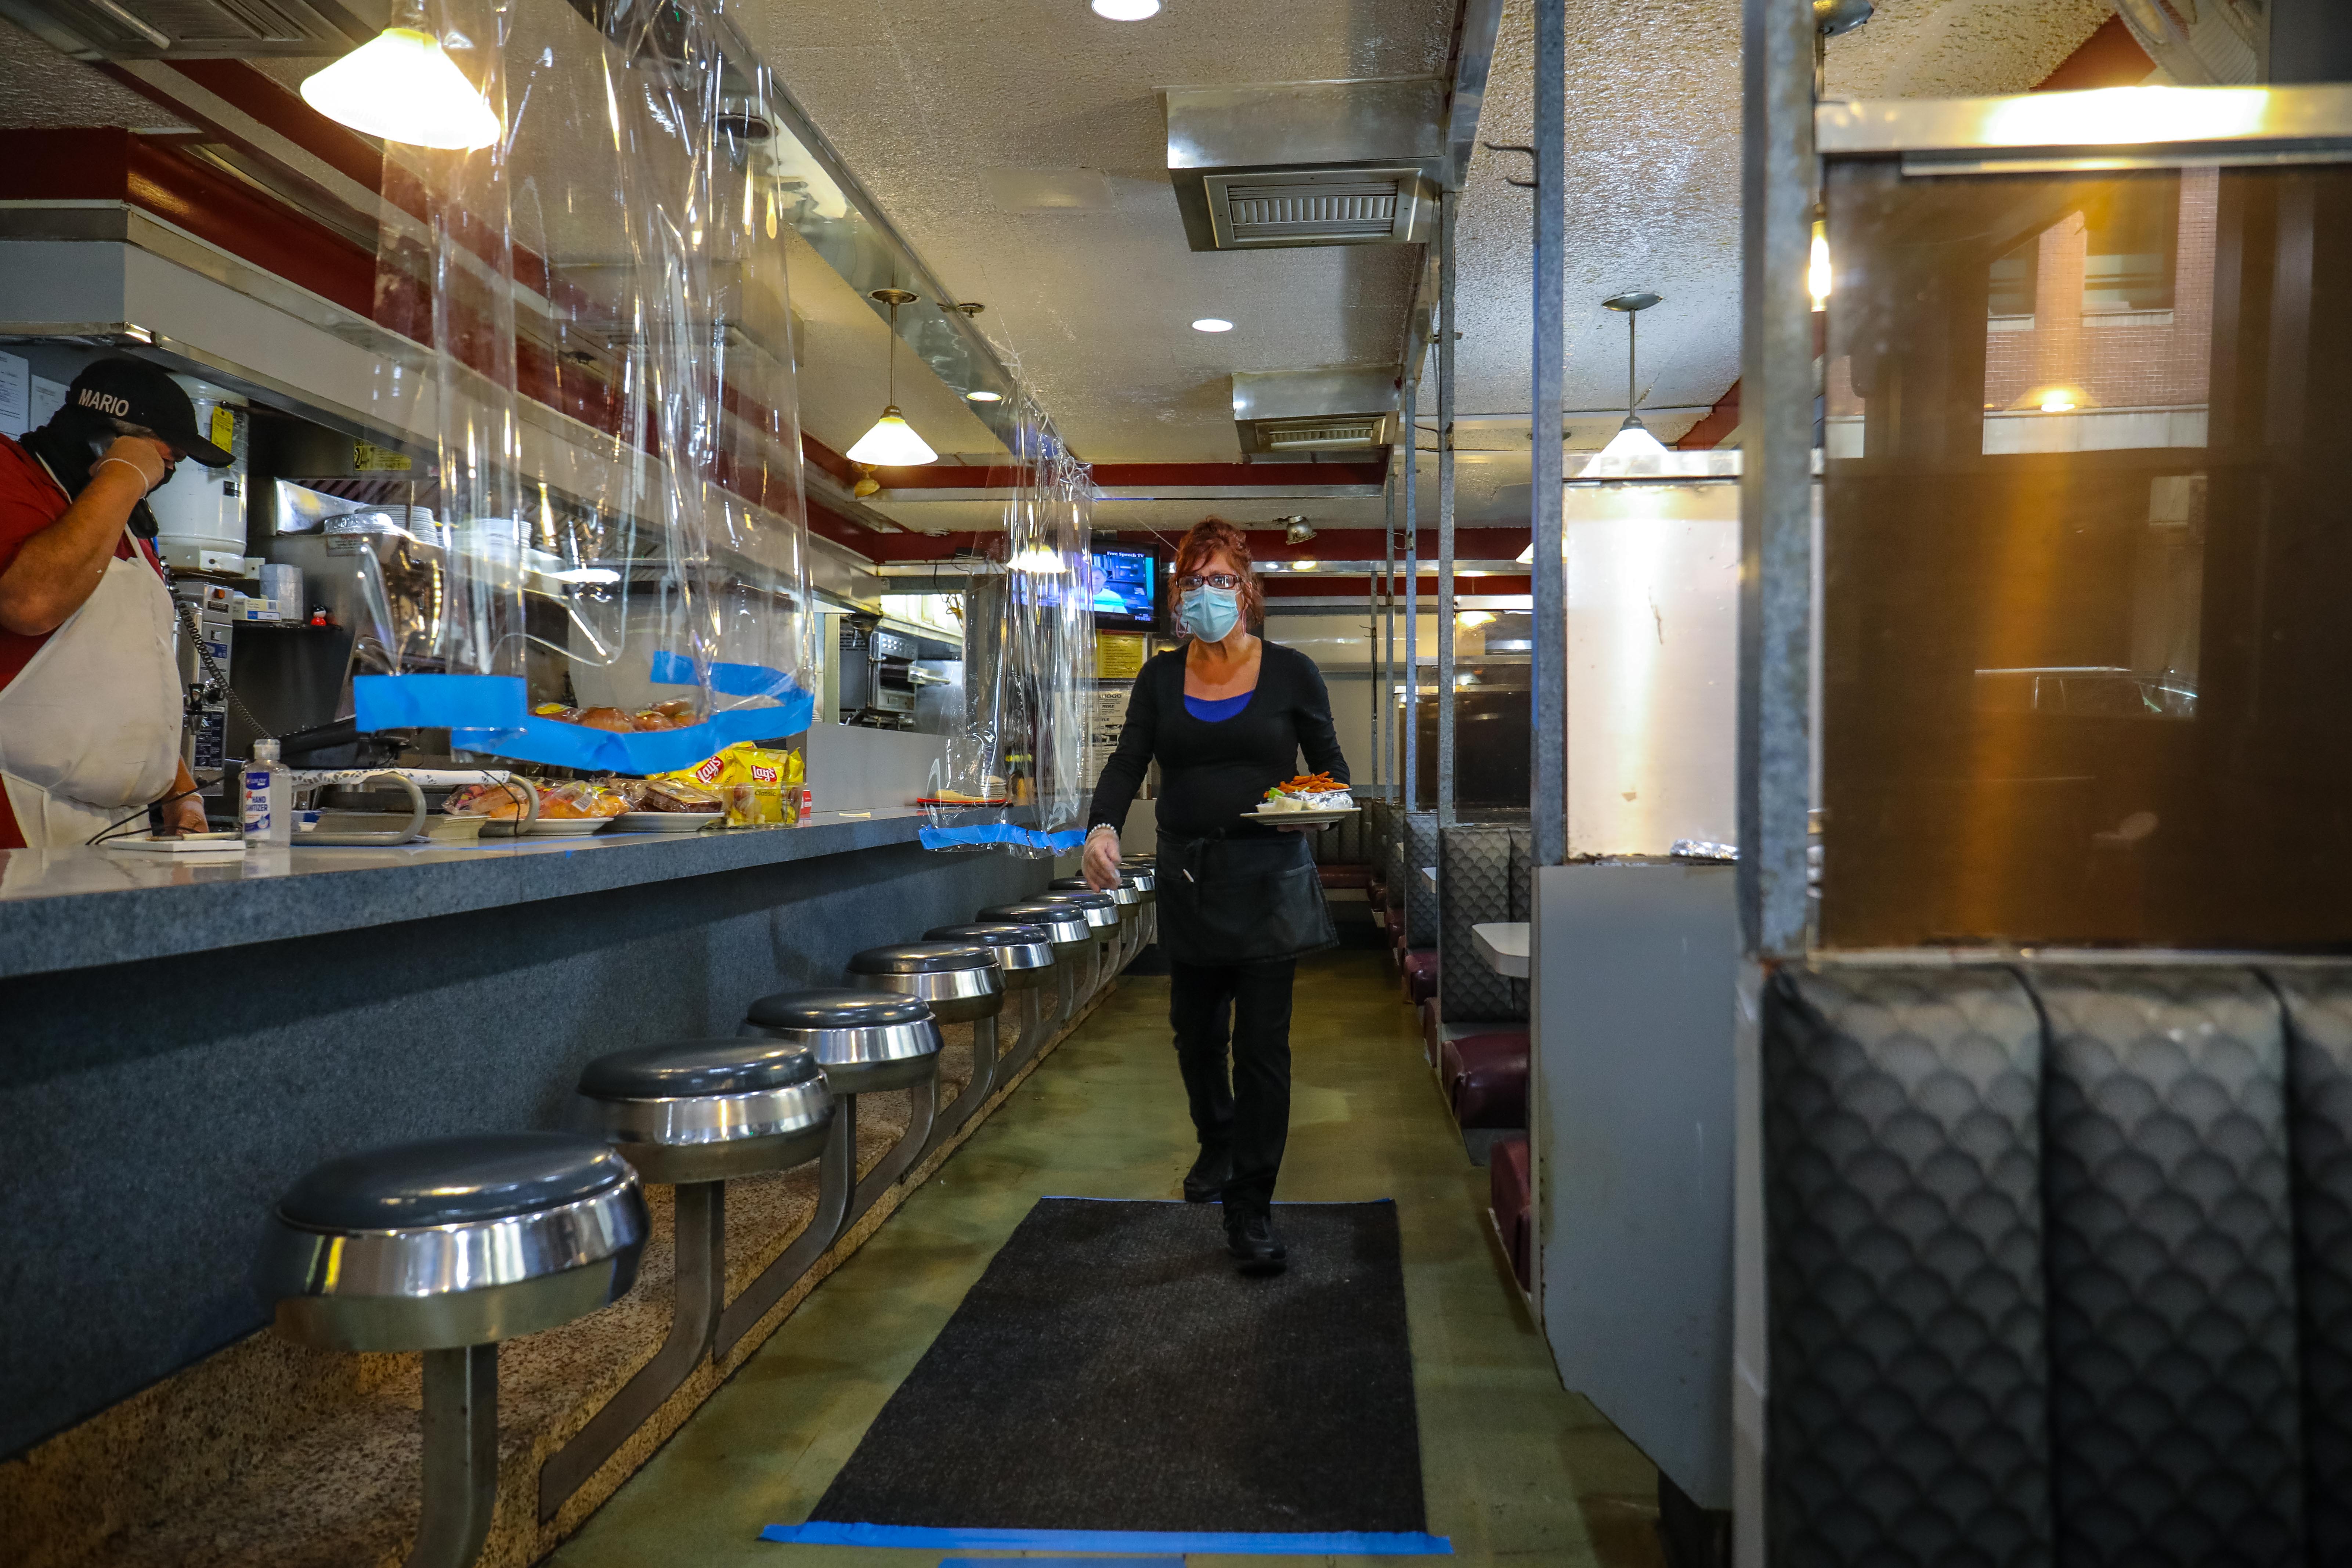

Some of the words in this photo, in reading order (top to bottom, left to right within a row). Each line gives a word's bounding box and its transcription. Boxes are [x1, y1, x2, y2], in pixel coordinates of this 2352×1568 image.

[78, 389, 130, 416] MARIO
[697, 756, 722, 784] Lay's
[753, 765, 775, 782] Lay's
